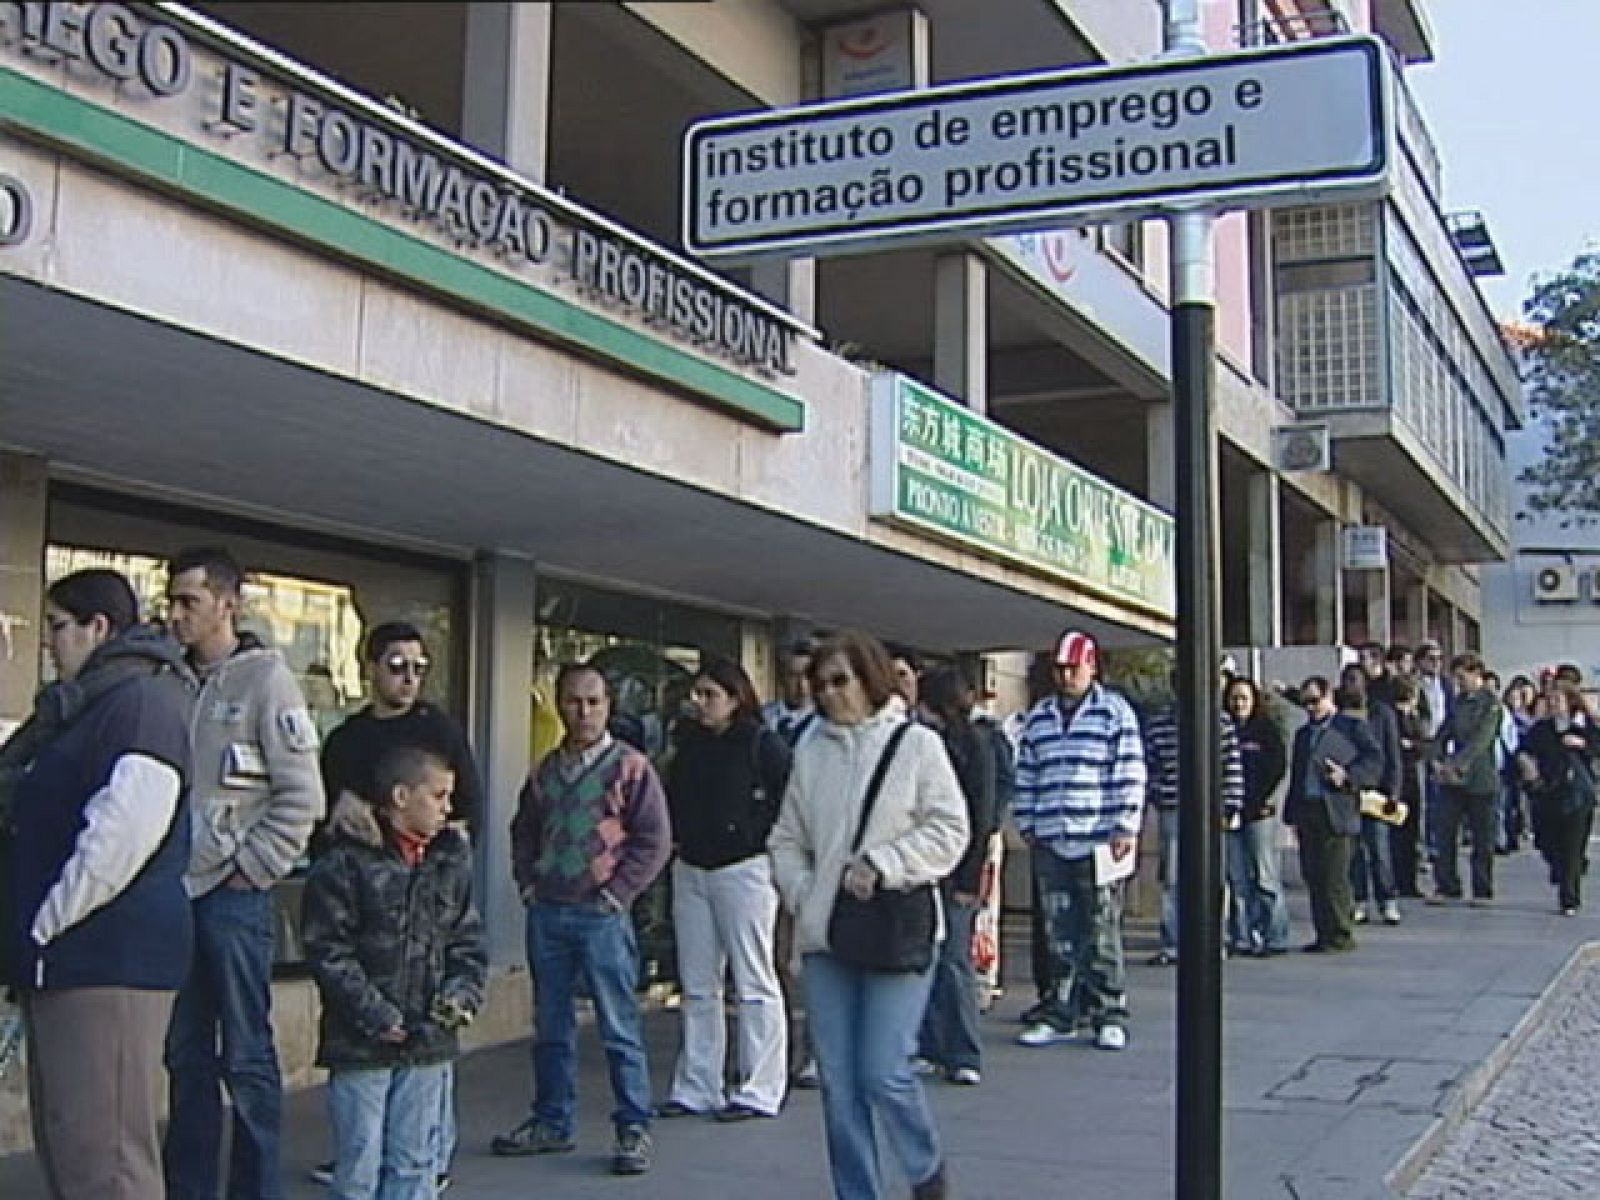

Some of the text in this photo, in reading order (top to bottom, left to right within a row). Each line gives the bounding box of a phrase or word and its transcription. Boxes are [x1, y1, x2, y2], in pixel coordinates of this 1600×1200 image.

[705, 80, 1263, 180] instituto de emprego e
[706, 125, 1236, 228] formação profissional
[220, 64, 262, 132] E
[574, 228, 796, 376] PROFISSIONAL
